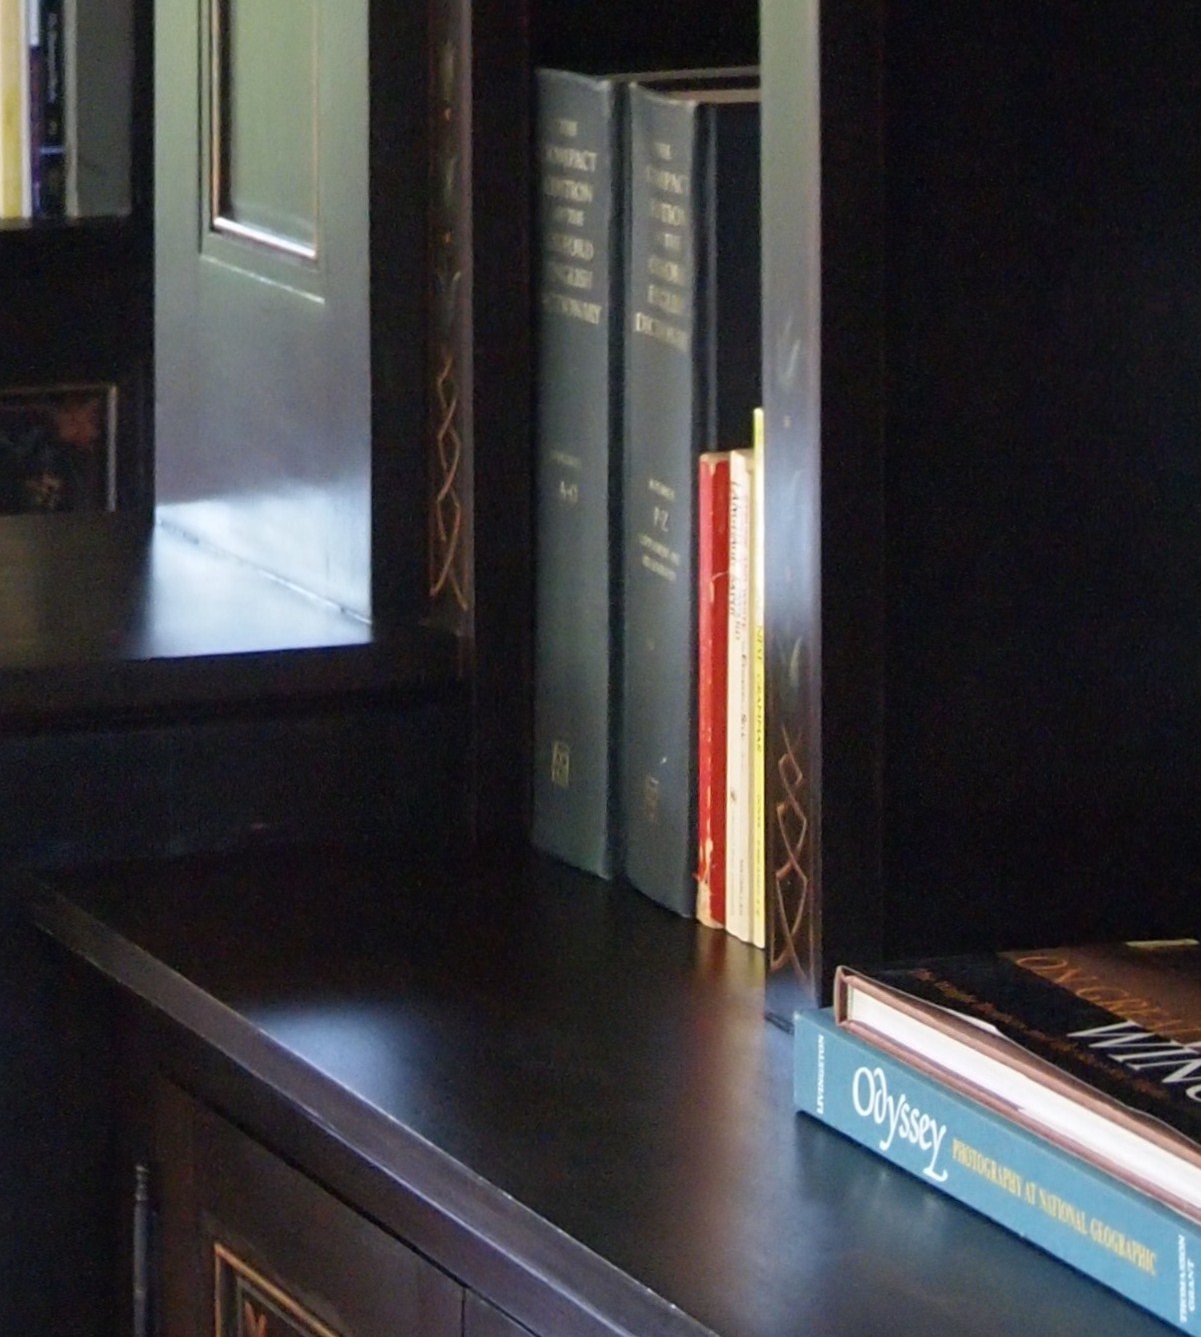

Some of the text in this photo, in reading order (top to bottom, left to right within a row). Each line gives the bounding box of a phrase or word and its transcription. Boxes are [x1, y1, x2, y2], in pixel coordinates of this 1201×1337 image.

[852, 1066, 949, 1183] Odyssey
[952, 1137, 1158, 1277] PHOTOGRAPHY AT NATIONAL GEOGRAPHIC
